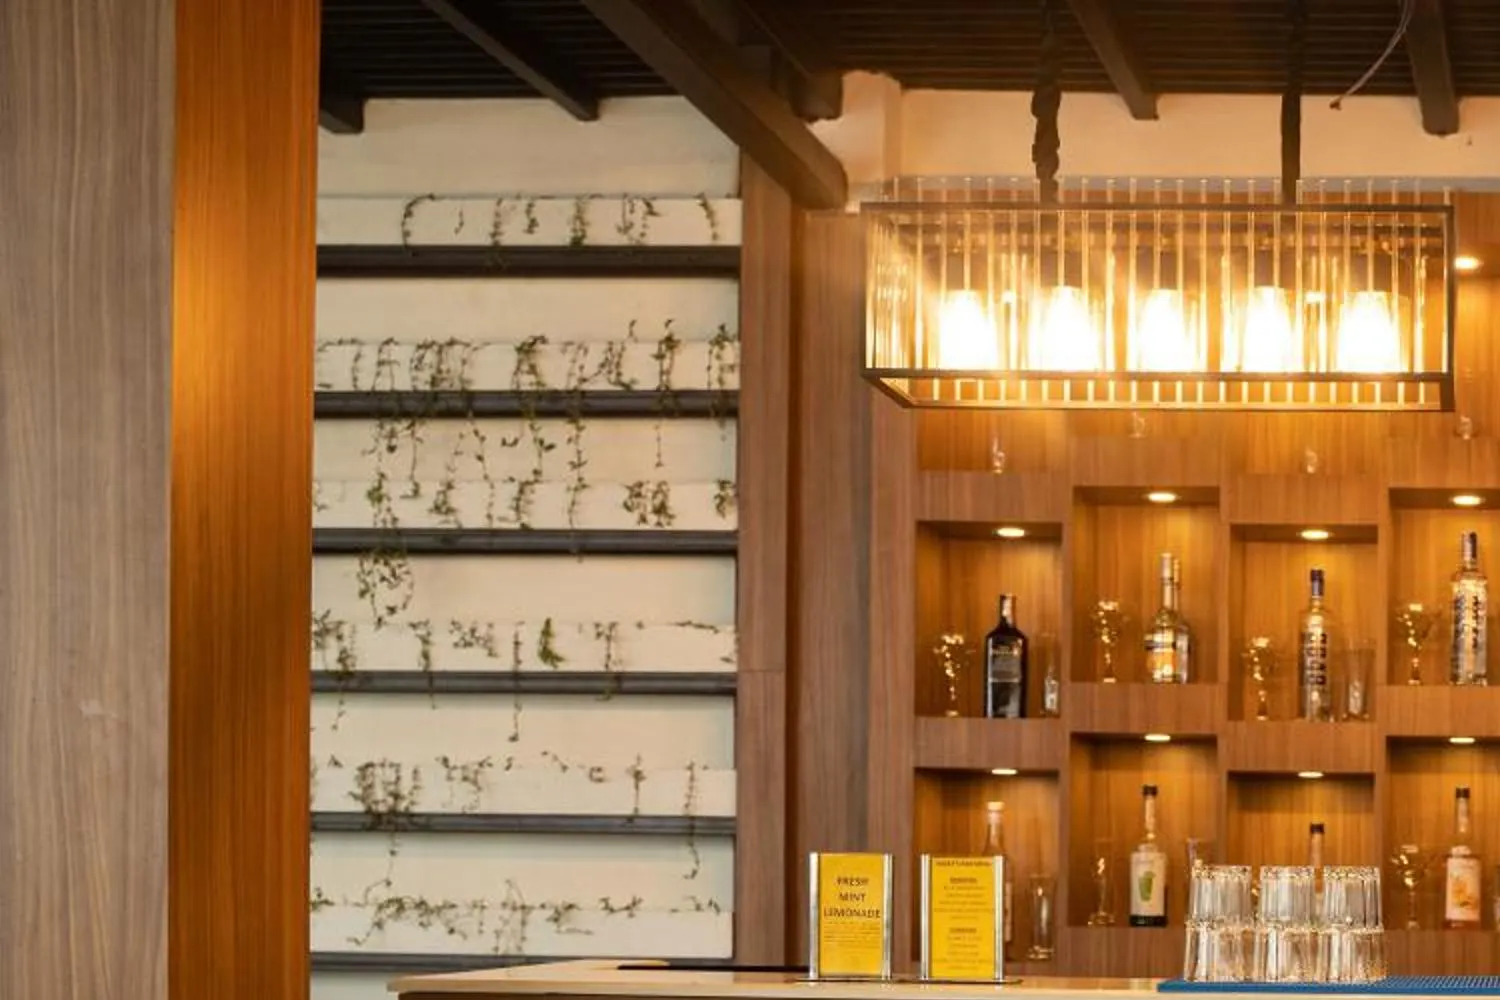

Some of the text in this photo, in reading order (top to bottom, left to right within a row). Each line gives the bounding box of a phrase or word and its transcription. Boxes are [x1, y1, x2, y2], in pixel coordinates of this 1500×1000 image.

[836, 876, 869, 886] FRESH
[839, 892, 866, 902] MINT
[823, 907, 881, 918] LEMONADE
